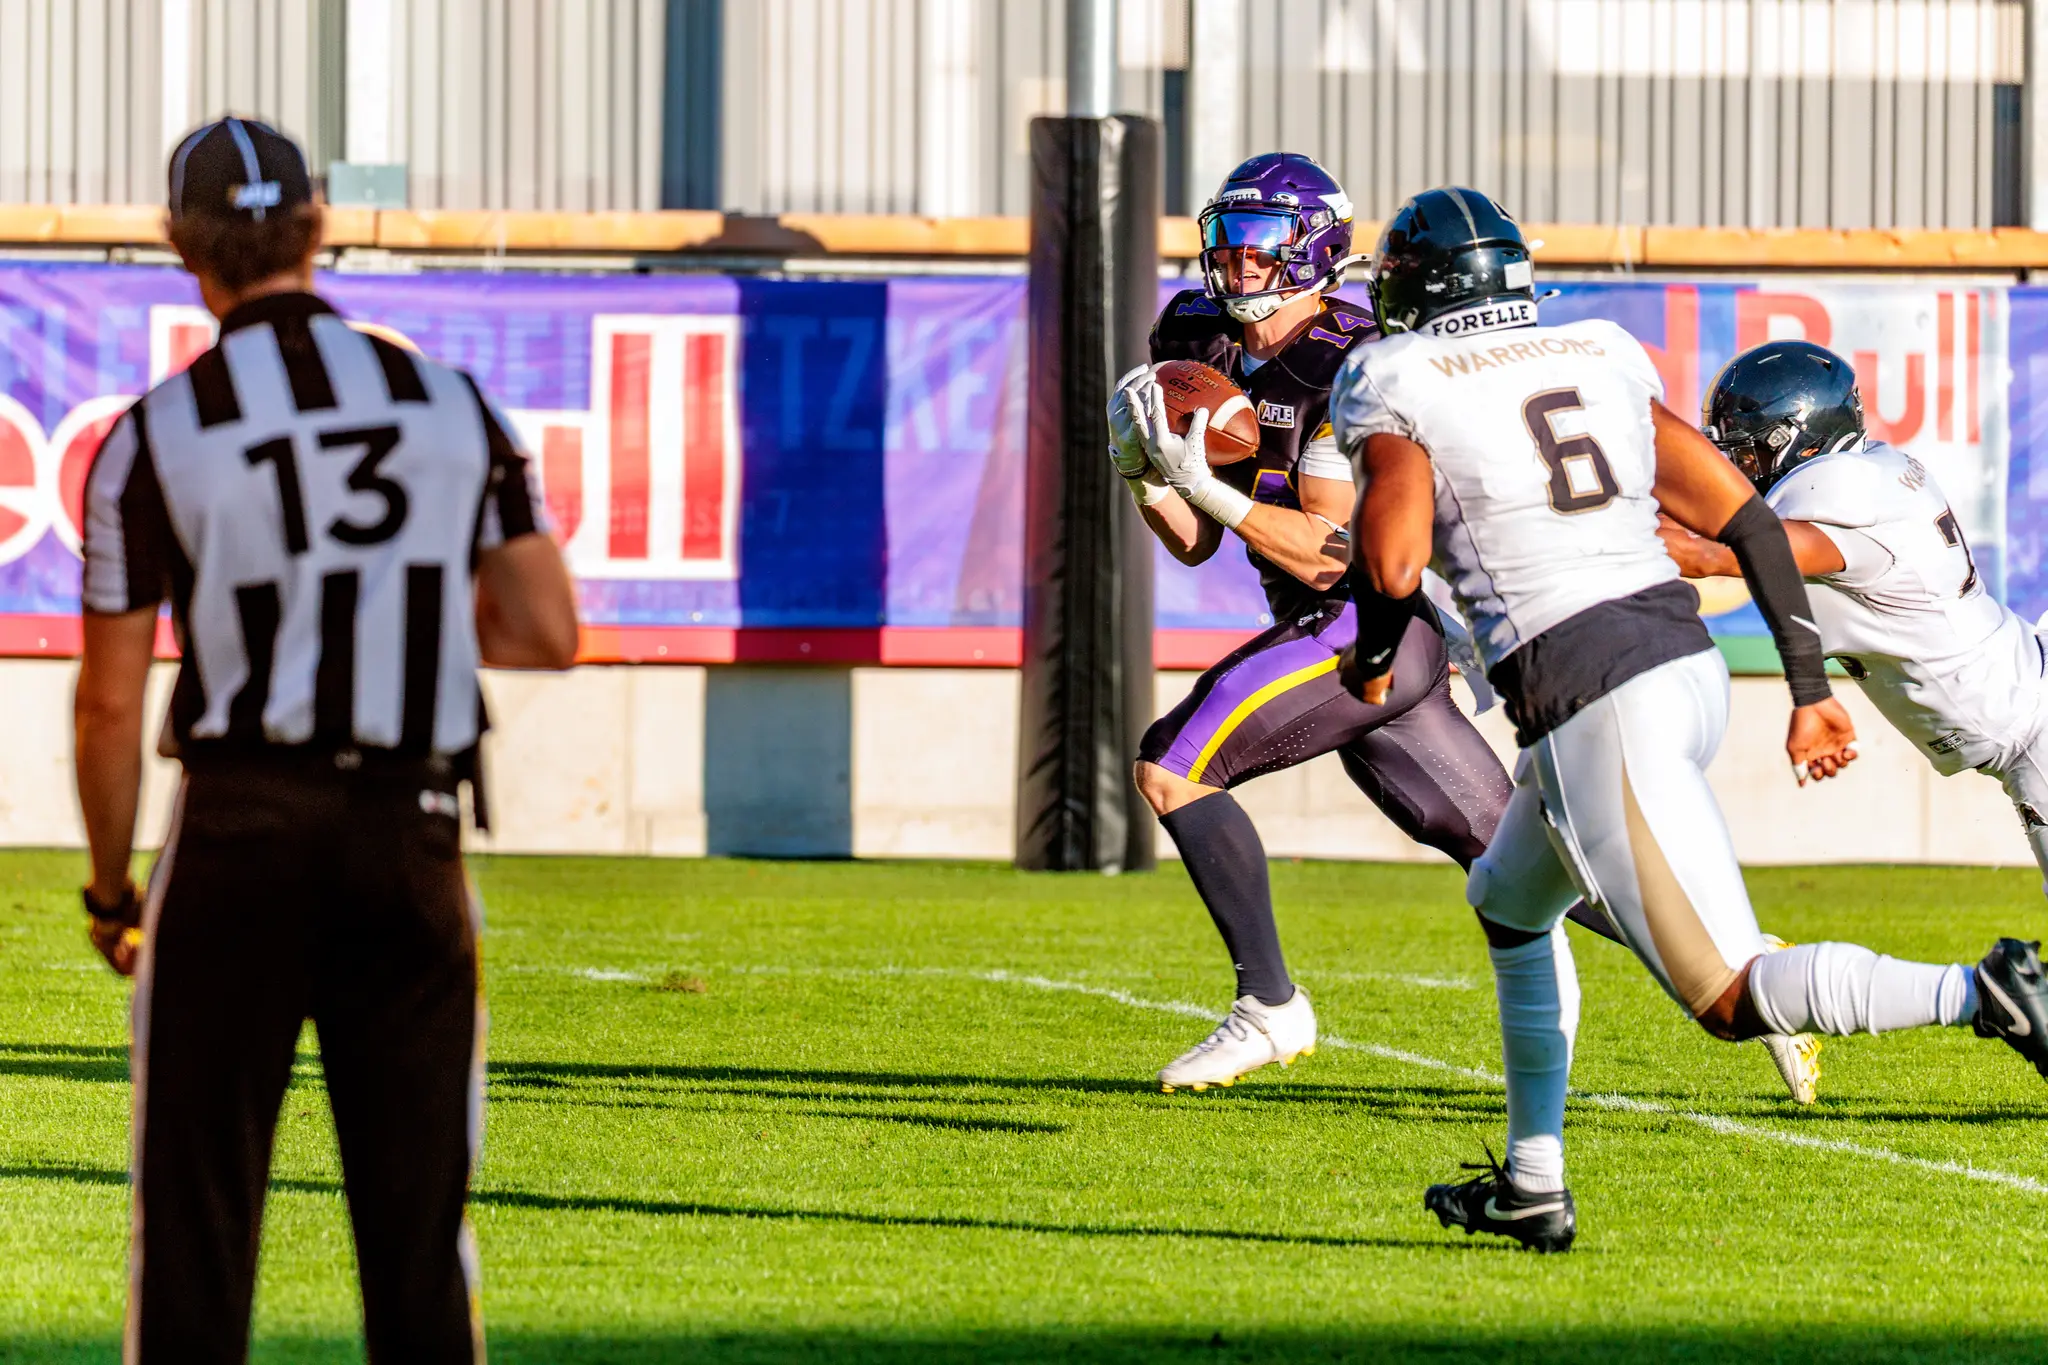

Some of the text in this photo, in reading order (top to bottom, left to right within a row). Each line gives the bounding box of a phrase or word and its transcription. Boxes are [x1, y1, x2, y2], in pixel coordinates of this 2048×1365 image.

[1220, 193, 1257, 203] FORELLE
[1308, 311, 1378, 350] 14
[1431, 303, 1530, 337] FORELLE
[1428, 337, 1606, 378] WARRIORS
[1168, 378, 1201, 395] GST
[1177, 363, 1219, 390] Wilson
[1167, 390, 1187, 403] NCAA
[1261, 405, 1292, 421] AFLE
[1520, 386, 1621, 516] 6
[244, 421, 409, 557] 13
